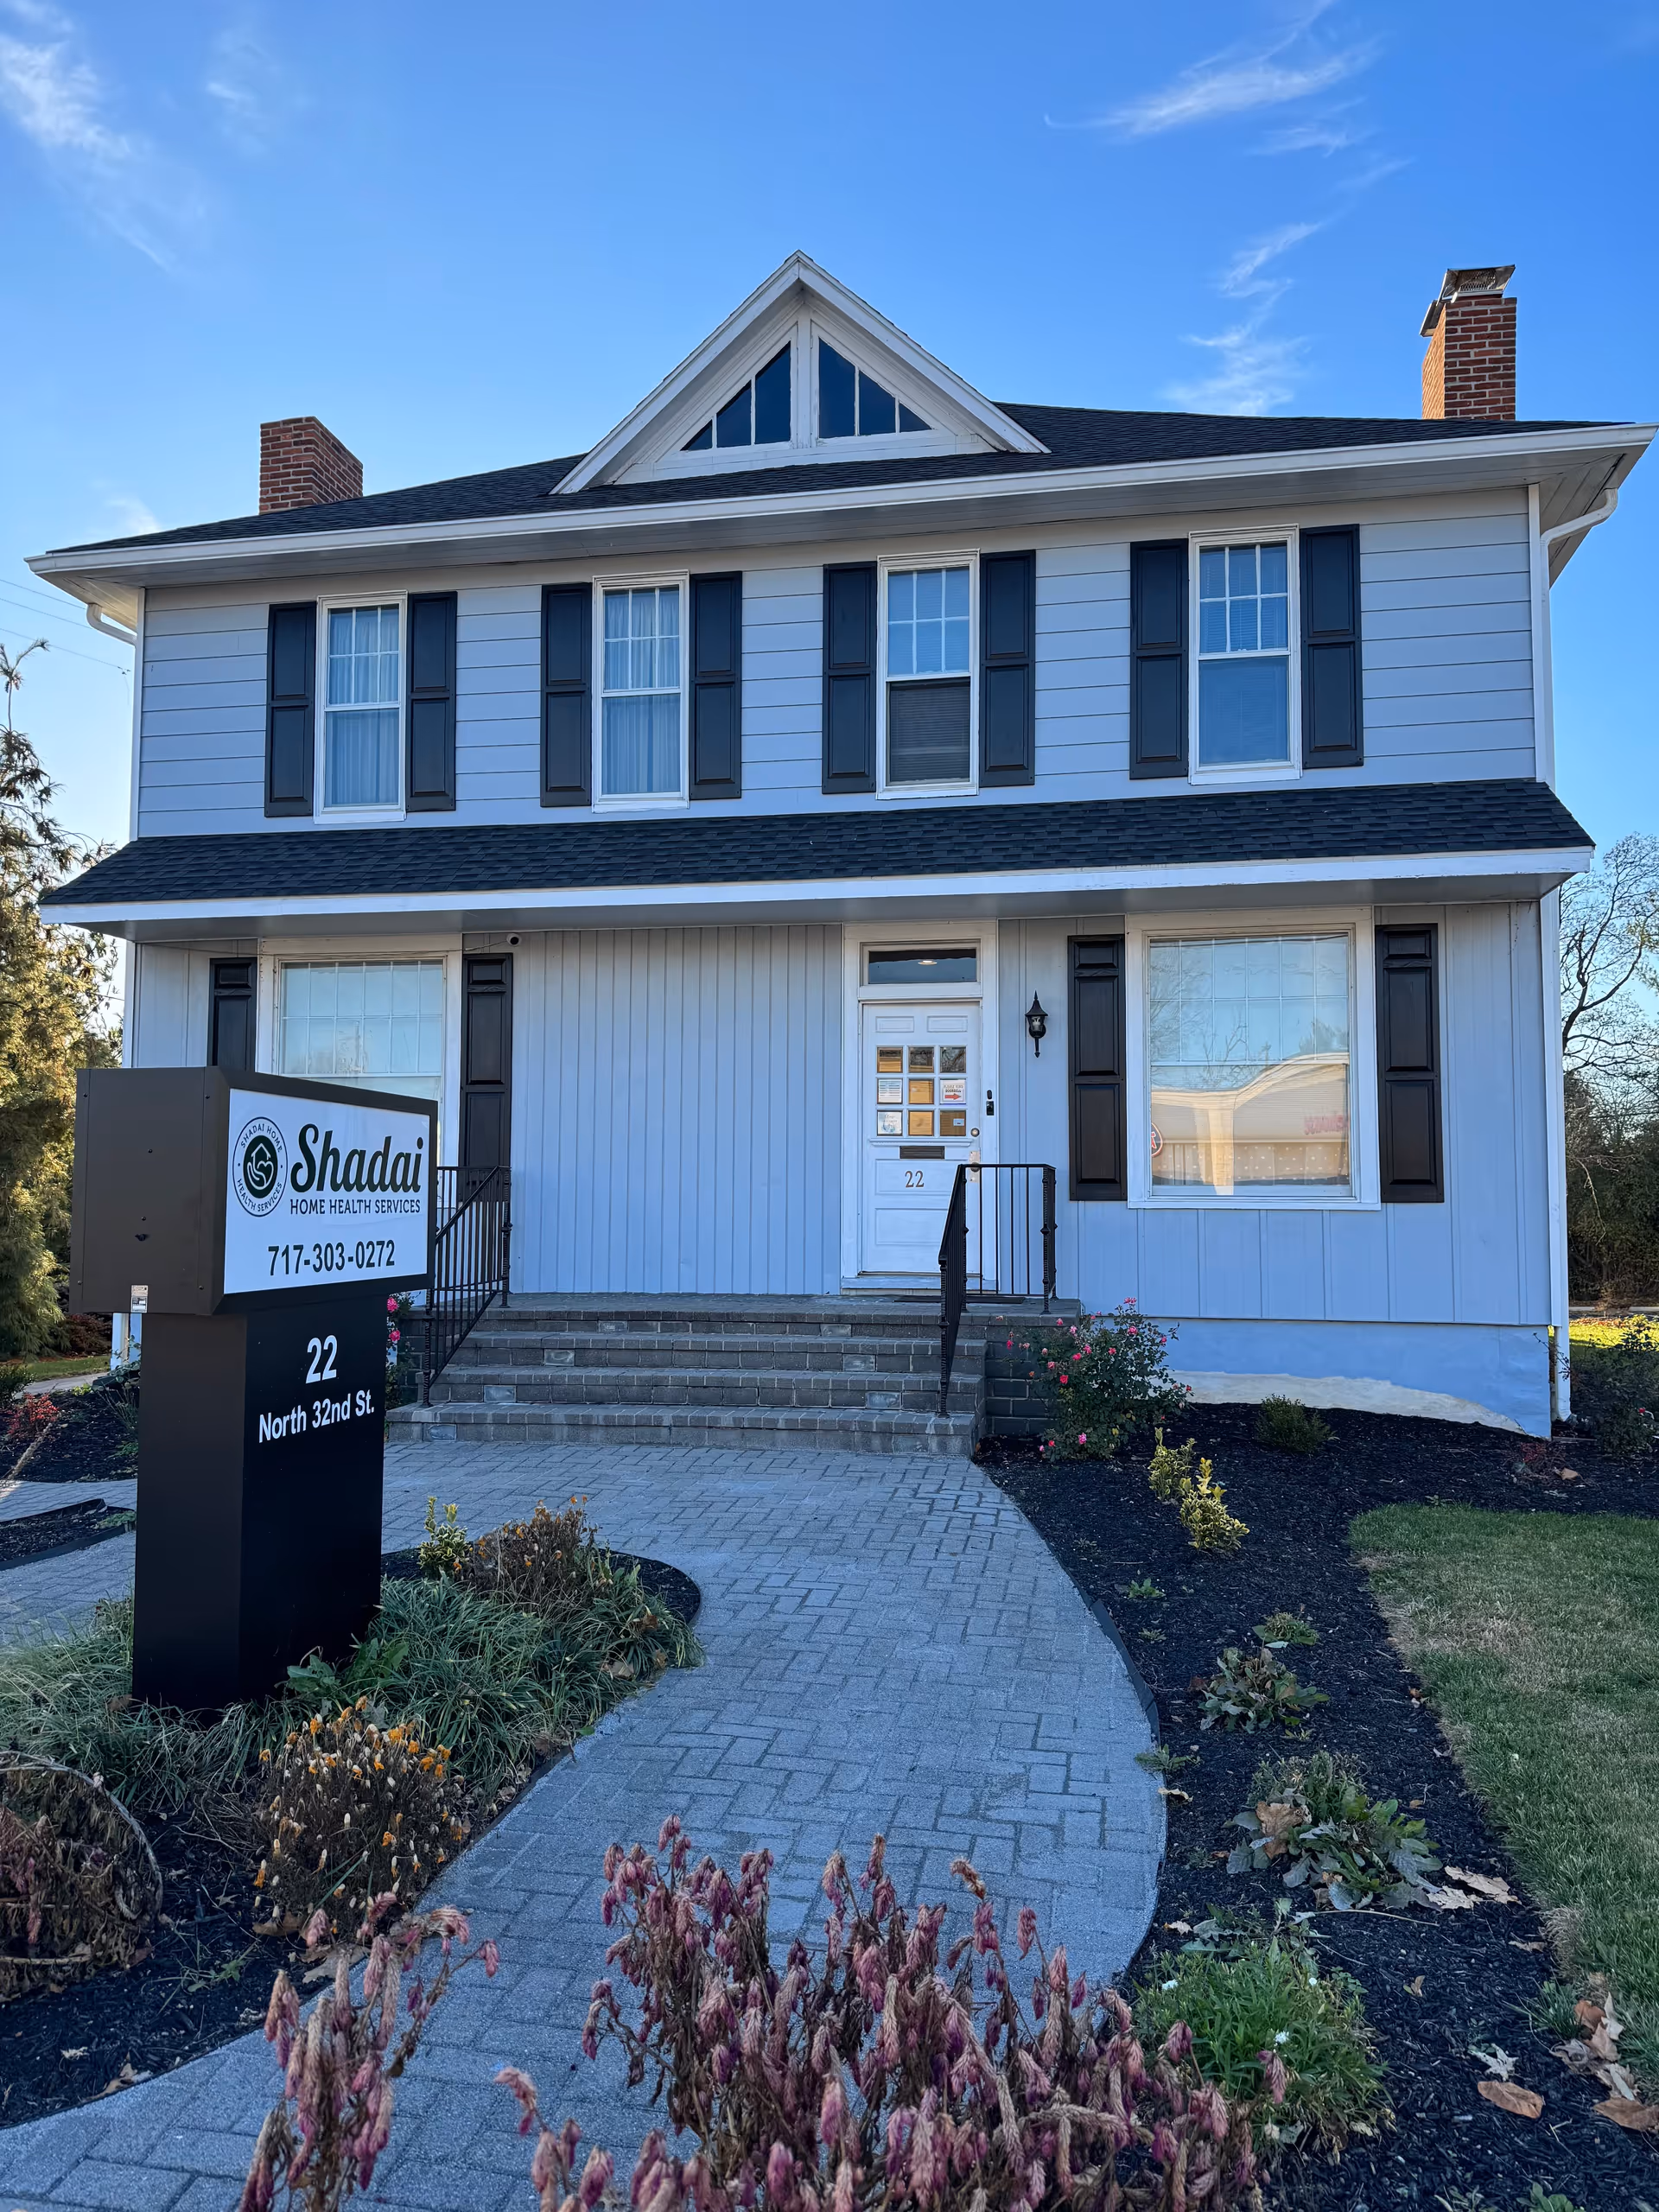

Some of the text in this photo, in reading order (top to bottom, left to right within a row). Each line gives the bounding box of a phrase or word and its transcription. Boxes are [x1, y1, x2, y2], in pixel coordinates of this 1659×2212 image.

[241, 1123, 283, 1153] SHADAI HOME
[290, 1123, 423, 1193] Shadai
[237, 1179, 283, 1211] HEALTH SERVICES
[905, 1170, 925, 1188] 22
[290, 1198, 421, 1214] HOME HEALTH SERVICES
[268, 1240, 395, 1276] 717-303-0272
[305, 1334, 338, 1384] 22
[259, 1389, 375, 1443] North 32nd St.
